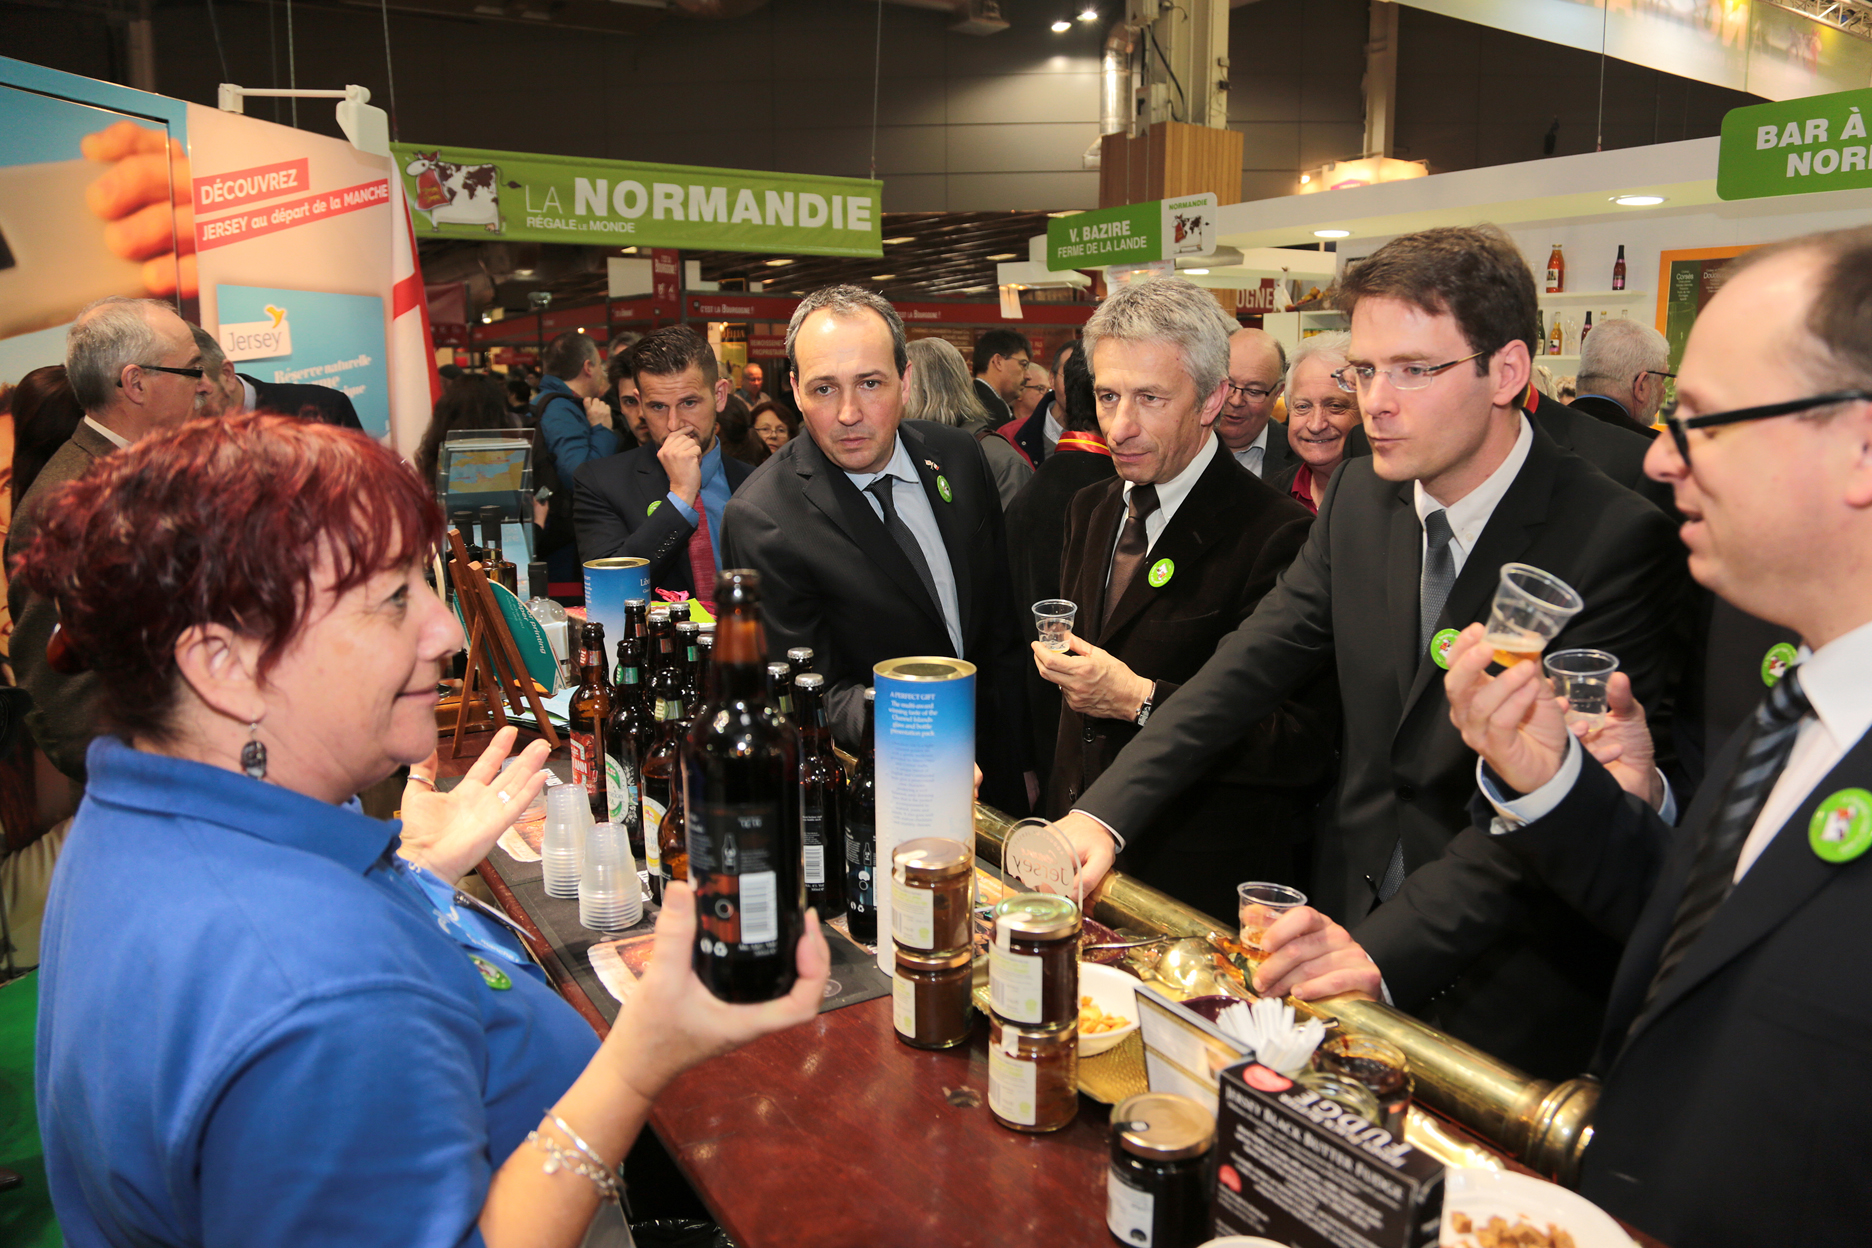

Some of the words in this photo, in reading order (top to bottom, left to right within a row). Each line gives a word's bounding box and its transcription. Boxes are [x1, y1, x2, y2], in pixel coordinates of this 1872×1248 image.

[1756, 118, 1829, 150] BAR
[1839, 106, 1867, 140] À
[1786, 144, 1872, 178] NOR
[200, 168, 298, 205] DÉCOUVREZ
[202, 216, 248, 241] JERSEY
[251, 215, 268, 229] au
[271, 202, 310, 225] départ
[312, 199, 328, 214] de
[330, 196, 342, 210] la
[343, 184, 389, 207] MANCHE
[525, 184, 563, 215] LA
[574, 177, 872, 231] NORMANDIE
[1168, 198, 1208, 211] NORMANDIE
[526, 215, 577, 230] RÉGALE
[577, 223, 588, 231] LE
[589, 221, 636, 233] MONDE
[1069, 228, 1080, 243] V.
[1082, 220, 1131, 242] BAZIRE
[1057, 244, 1085, 258] FERME
[1086, 242, 1099, 255] DE
[1101, 240, 1112, 253] LA
[1114, 236, 1148, 252] LANDE
[1236, 287, 1274, 309] OGNE
[227, 330, 282, 352] Jersey
[274, 366, 323, 384] Réserve
[325, 354, 372, 374] naturelle
[530, 620, 547, 655] printing
[1297, 1089, 1413, 1158] FUDGE
[1225, 1084, 1263, 1117] JERSEY
[1263, 1106, 1303, 1142] BLACK
[1303, 1130, 1355, 1172] BUTTER
[1355, 1160, 1404, 1200] FUDGE
